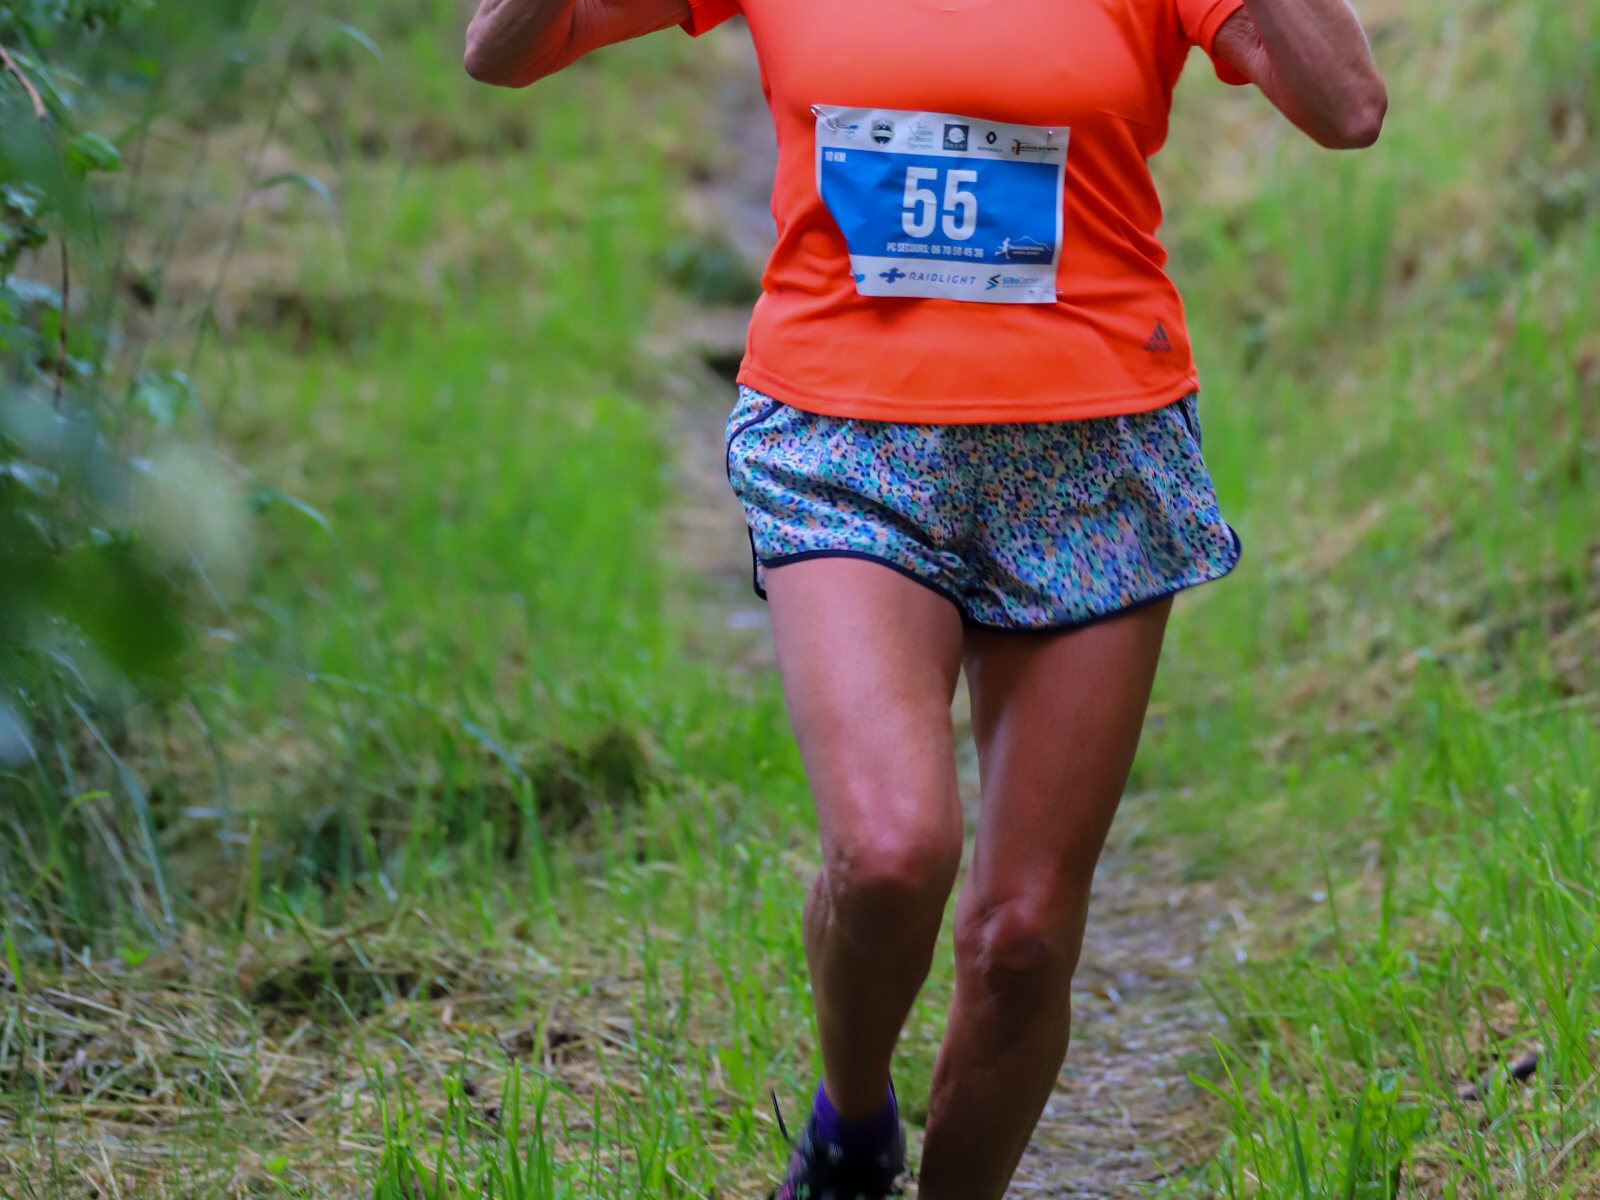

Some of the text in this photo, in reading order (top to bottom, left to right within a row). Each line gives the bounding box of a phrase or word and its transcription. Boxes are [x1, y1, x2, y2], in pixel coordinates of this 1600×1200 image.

[902, 166, 977, 240] 55
[886, 242, 897, 252] PC
[908, 272, 976, 285] RAIDLIGHT
